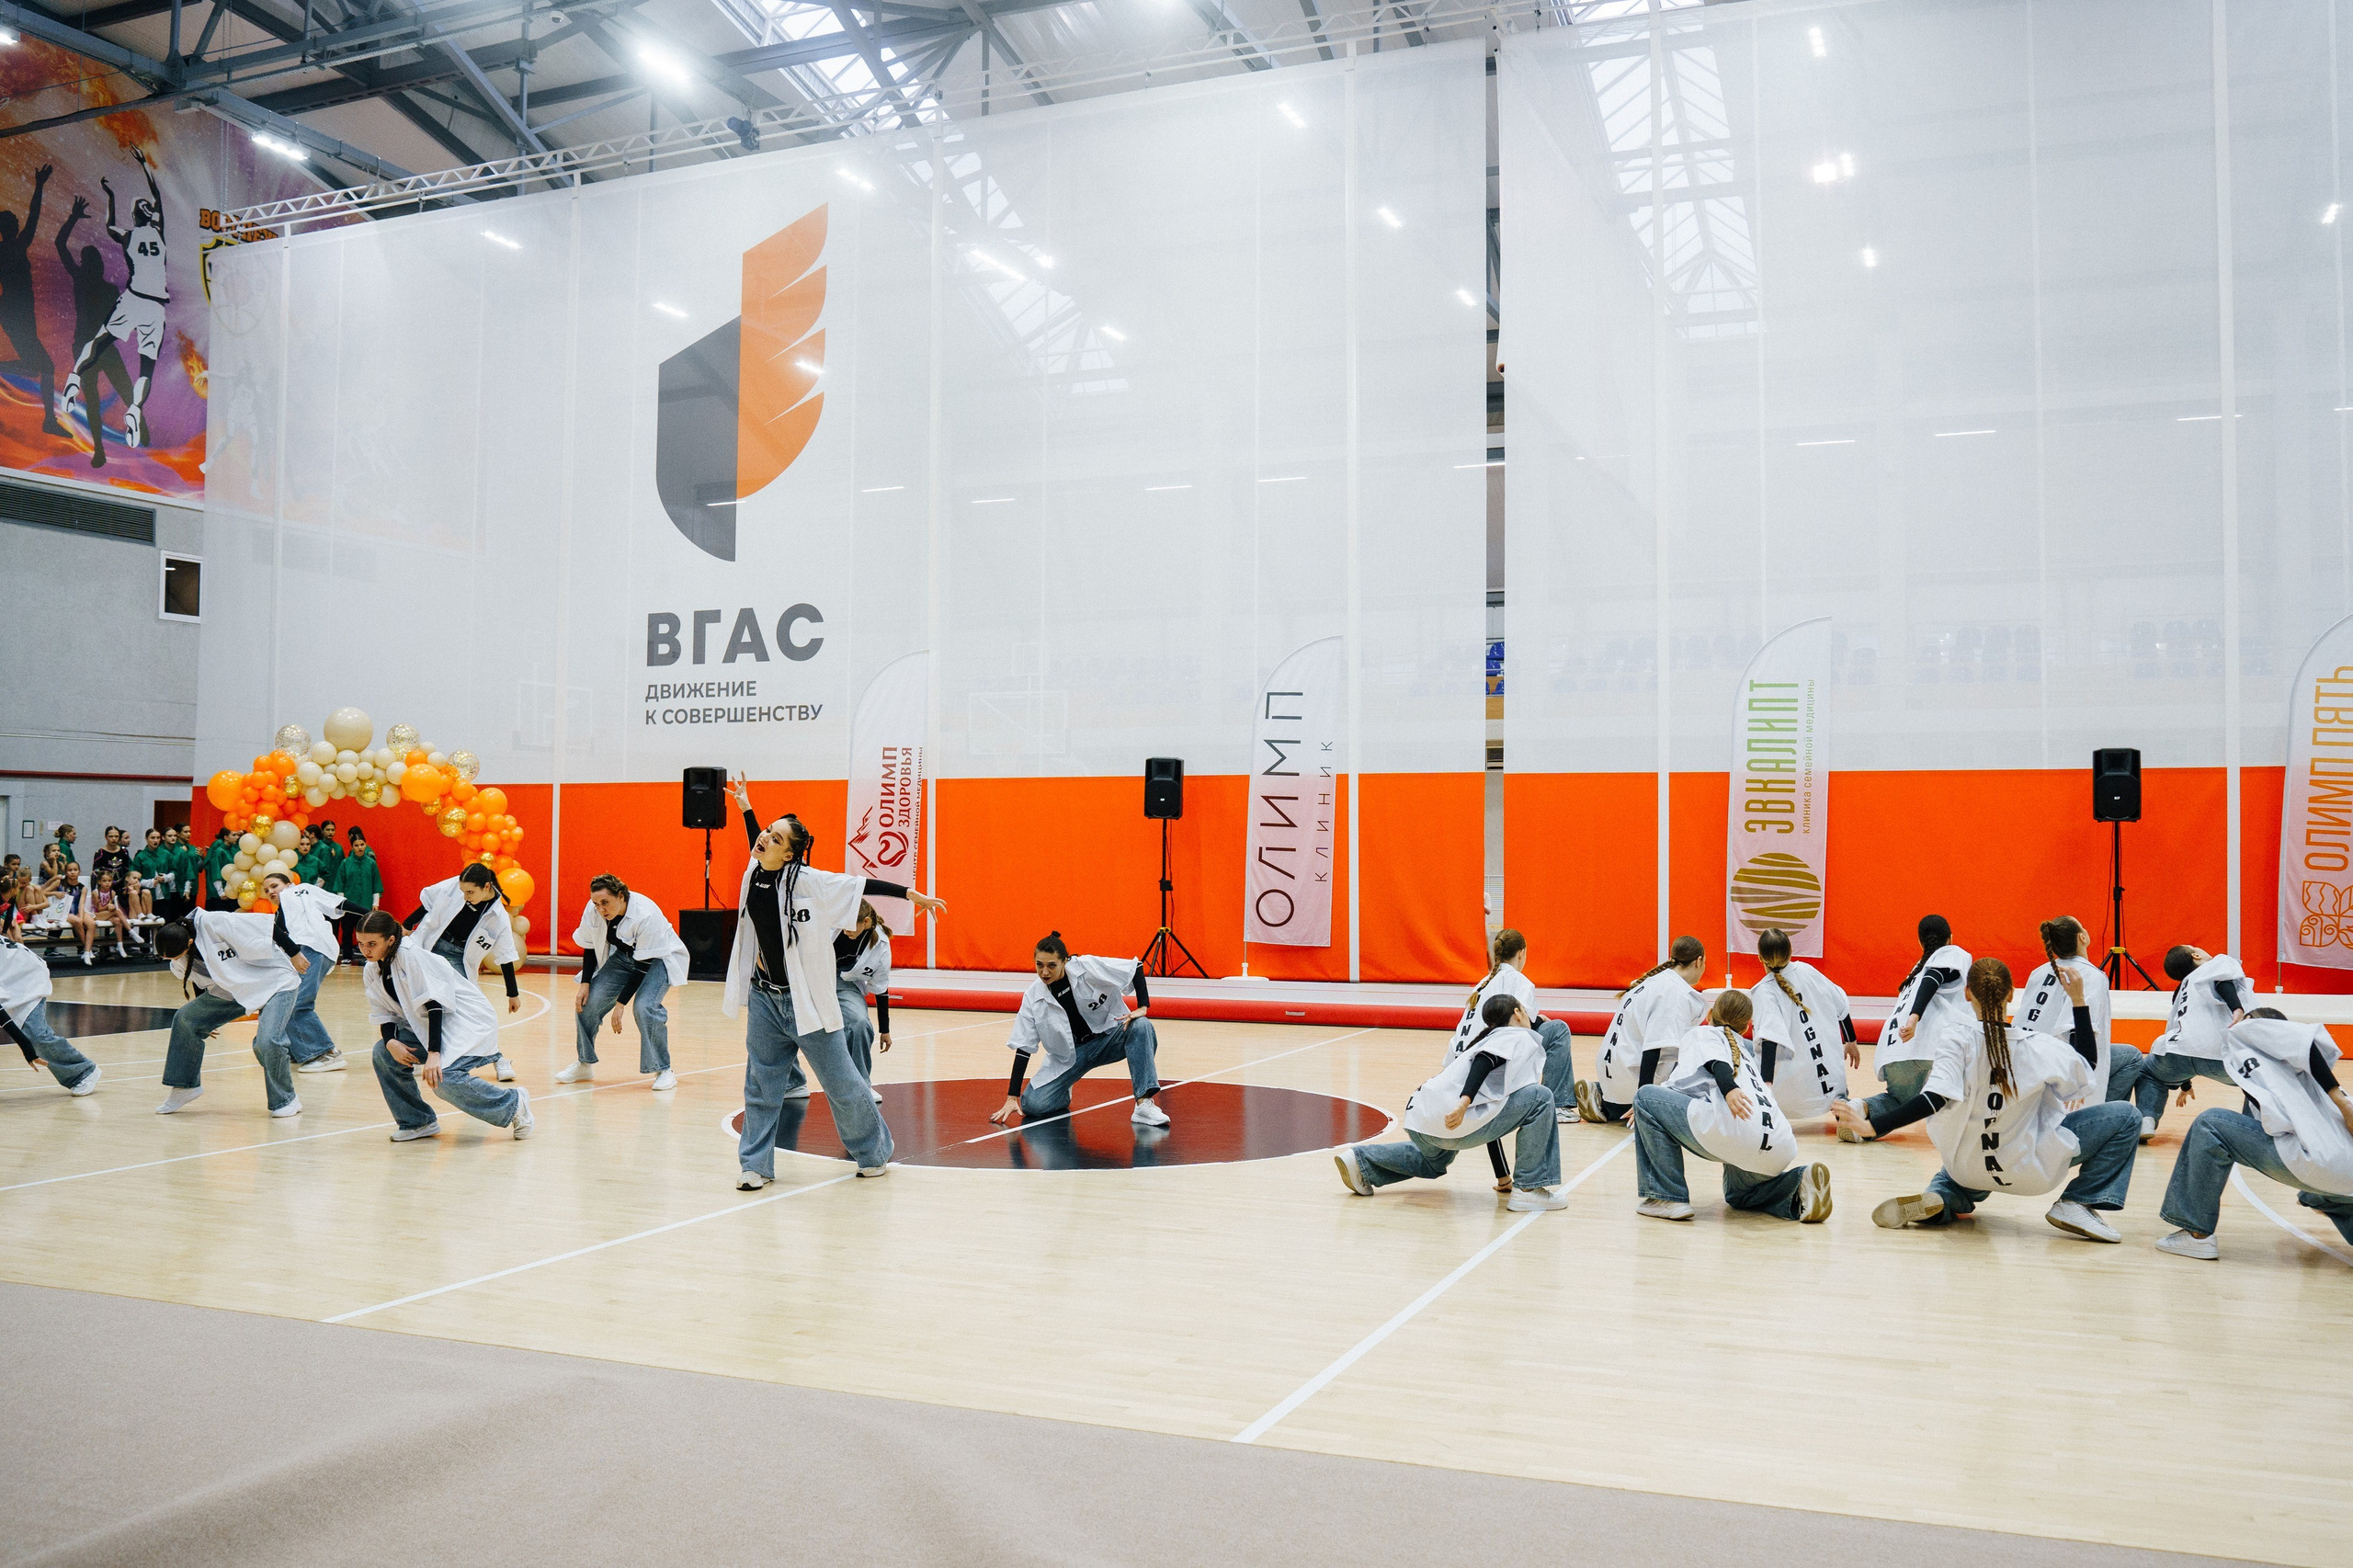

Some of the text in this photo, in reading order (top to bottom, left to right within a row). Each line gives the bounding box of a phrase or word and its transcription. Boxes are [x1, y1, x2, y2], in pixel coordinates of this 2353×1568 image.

[138, 241, 160, 256] 45
[646, 602, 824, 667] ВГАС
[644, 680, 757, 703] ДВИЖЕНИЕ
[645, 704, 824, 725] К СОВЕРШЕНСТВУ
[879, 745, 898, 828] ОЛИМП
[898, 746, 913, 828] ЗДОРОВЬЯ
[1744, 678, 1799, 835] ЭВКАЛИПТ
[1802, 679, 1816, 835] клиника семейной медицины
[2303, 665, 2353, 872] ОЛИМП ПЯТЬ
[1256, 691, 1303, 927] ОЛИМП
[1314, 741, 1333, 882] КЛИНИК
[217, 948, 236, 961] 28
[1087, 993, 1108, 1012] 28
